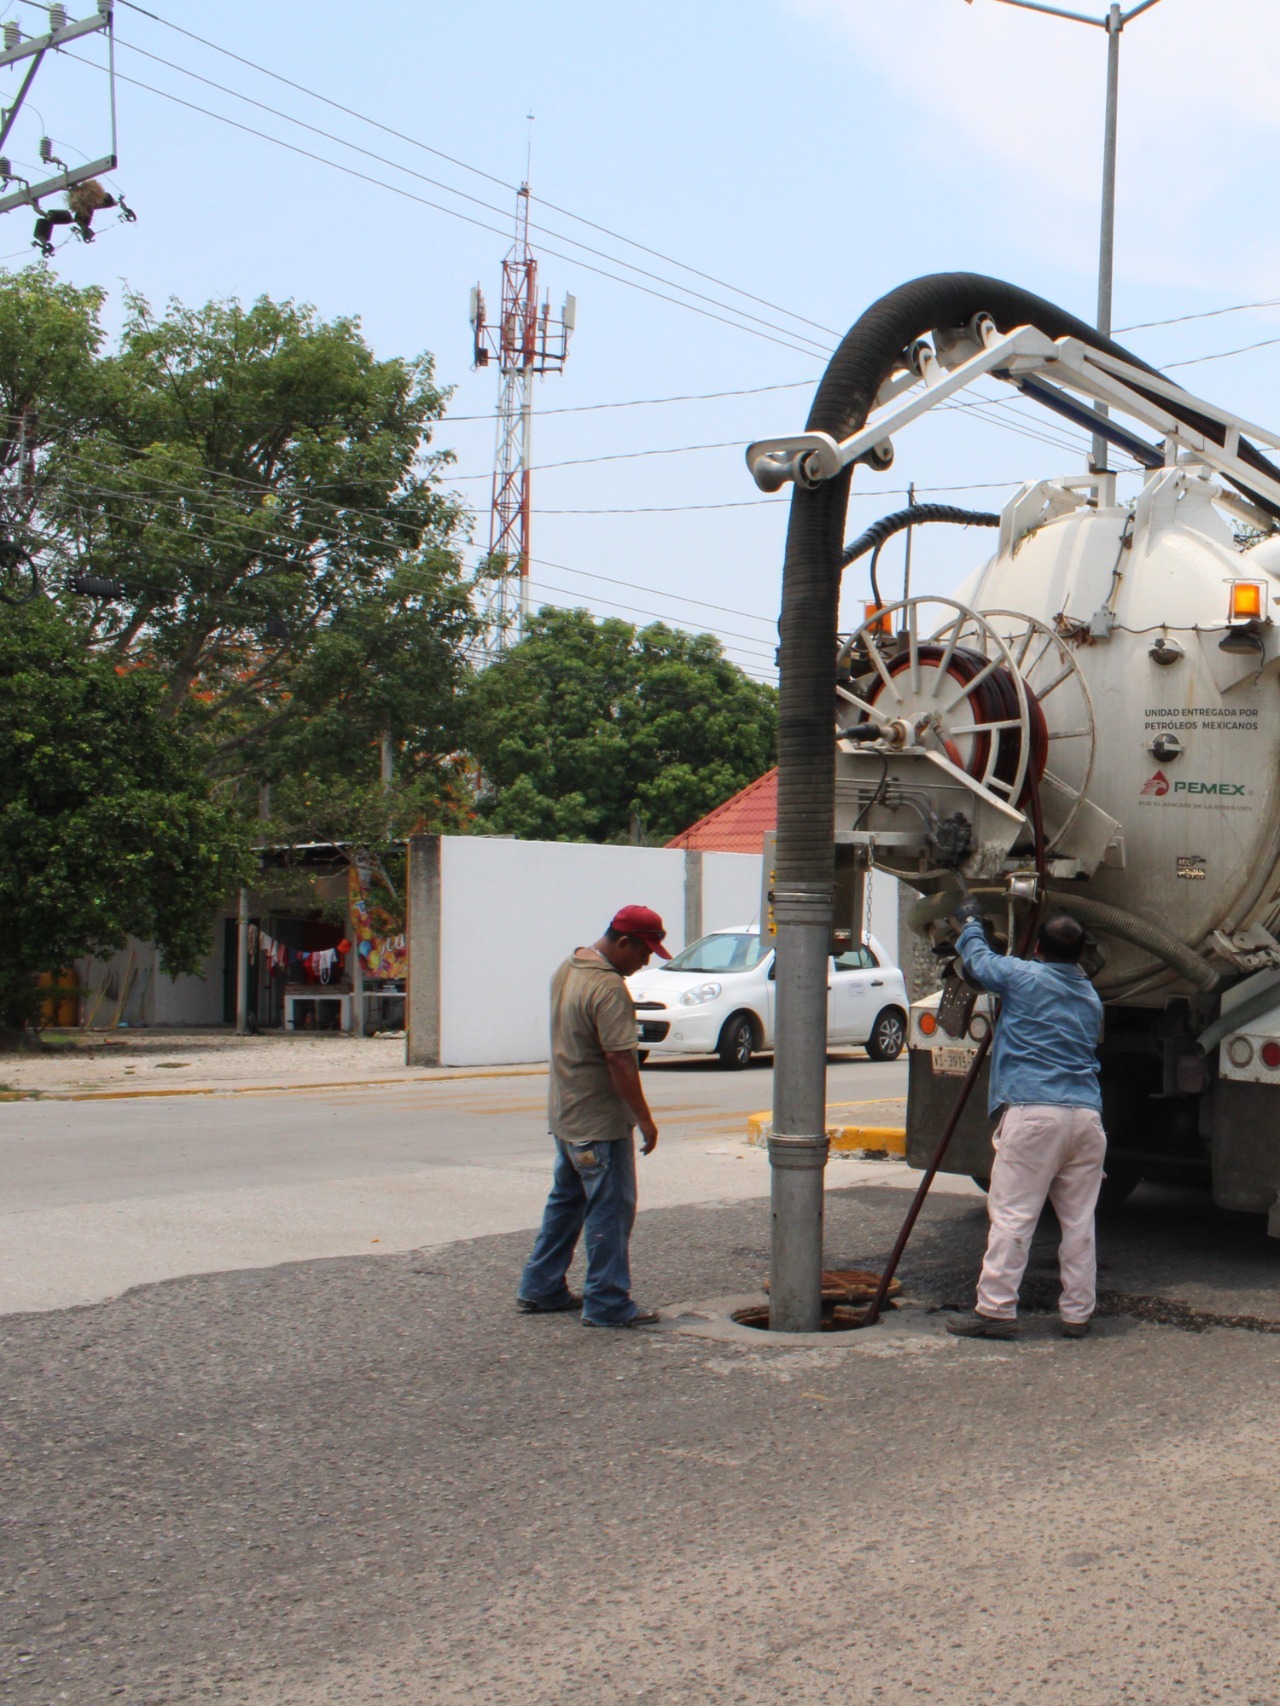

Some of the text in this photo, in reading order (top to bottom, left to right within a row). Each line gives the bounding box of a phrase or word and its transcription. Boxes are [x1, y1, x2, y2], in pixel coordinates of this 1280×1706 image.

[1144, 708, 1258, 717] UNIDAD ENTREGADA POR
[1144, 720, 1258, 730] PETRÓLEOS MEXICANOS
[1174, 781, 1246, 796] PEMEX
[934, 1054, 972, 1069] VS-3915-
